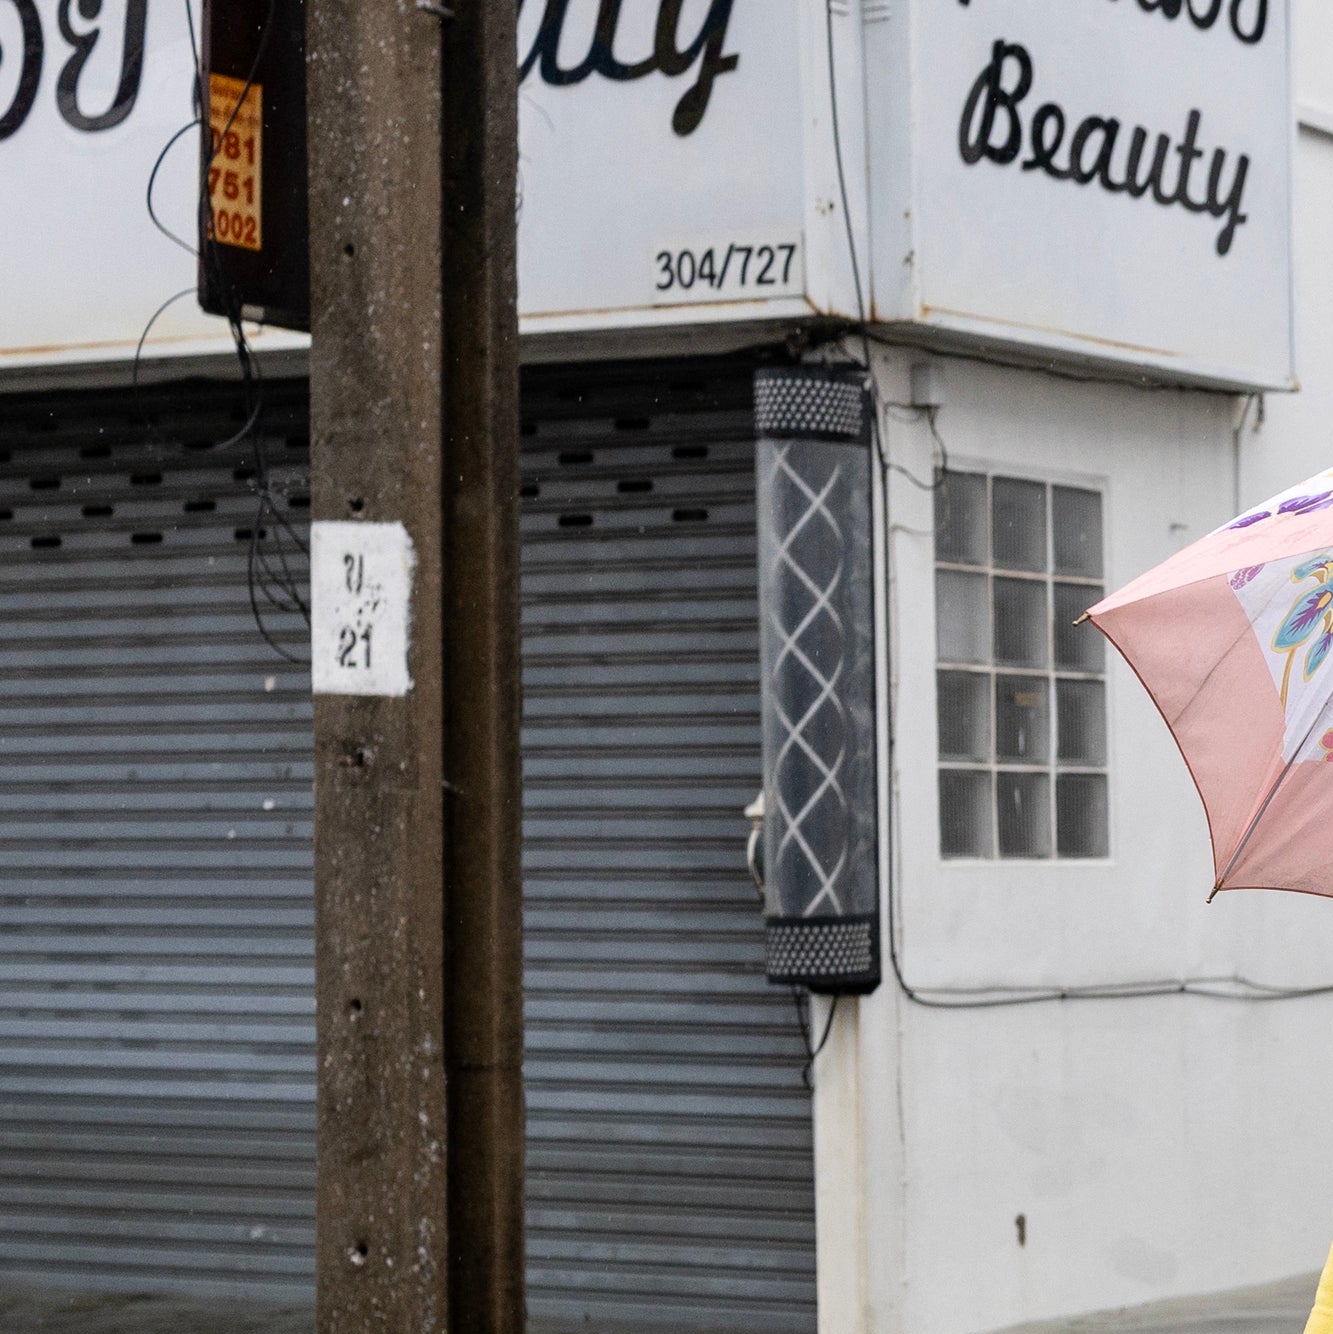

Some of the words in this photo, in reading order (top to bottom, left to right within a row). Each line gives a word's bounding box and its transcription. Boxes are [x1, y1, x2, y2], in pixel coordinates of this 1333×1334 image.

[959, 39, 1250, 256] Beauty
[208, 168, 254, 205] 751
[207, 208, 257, 245] 002
[655, 243, 797, 291] 304/727
